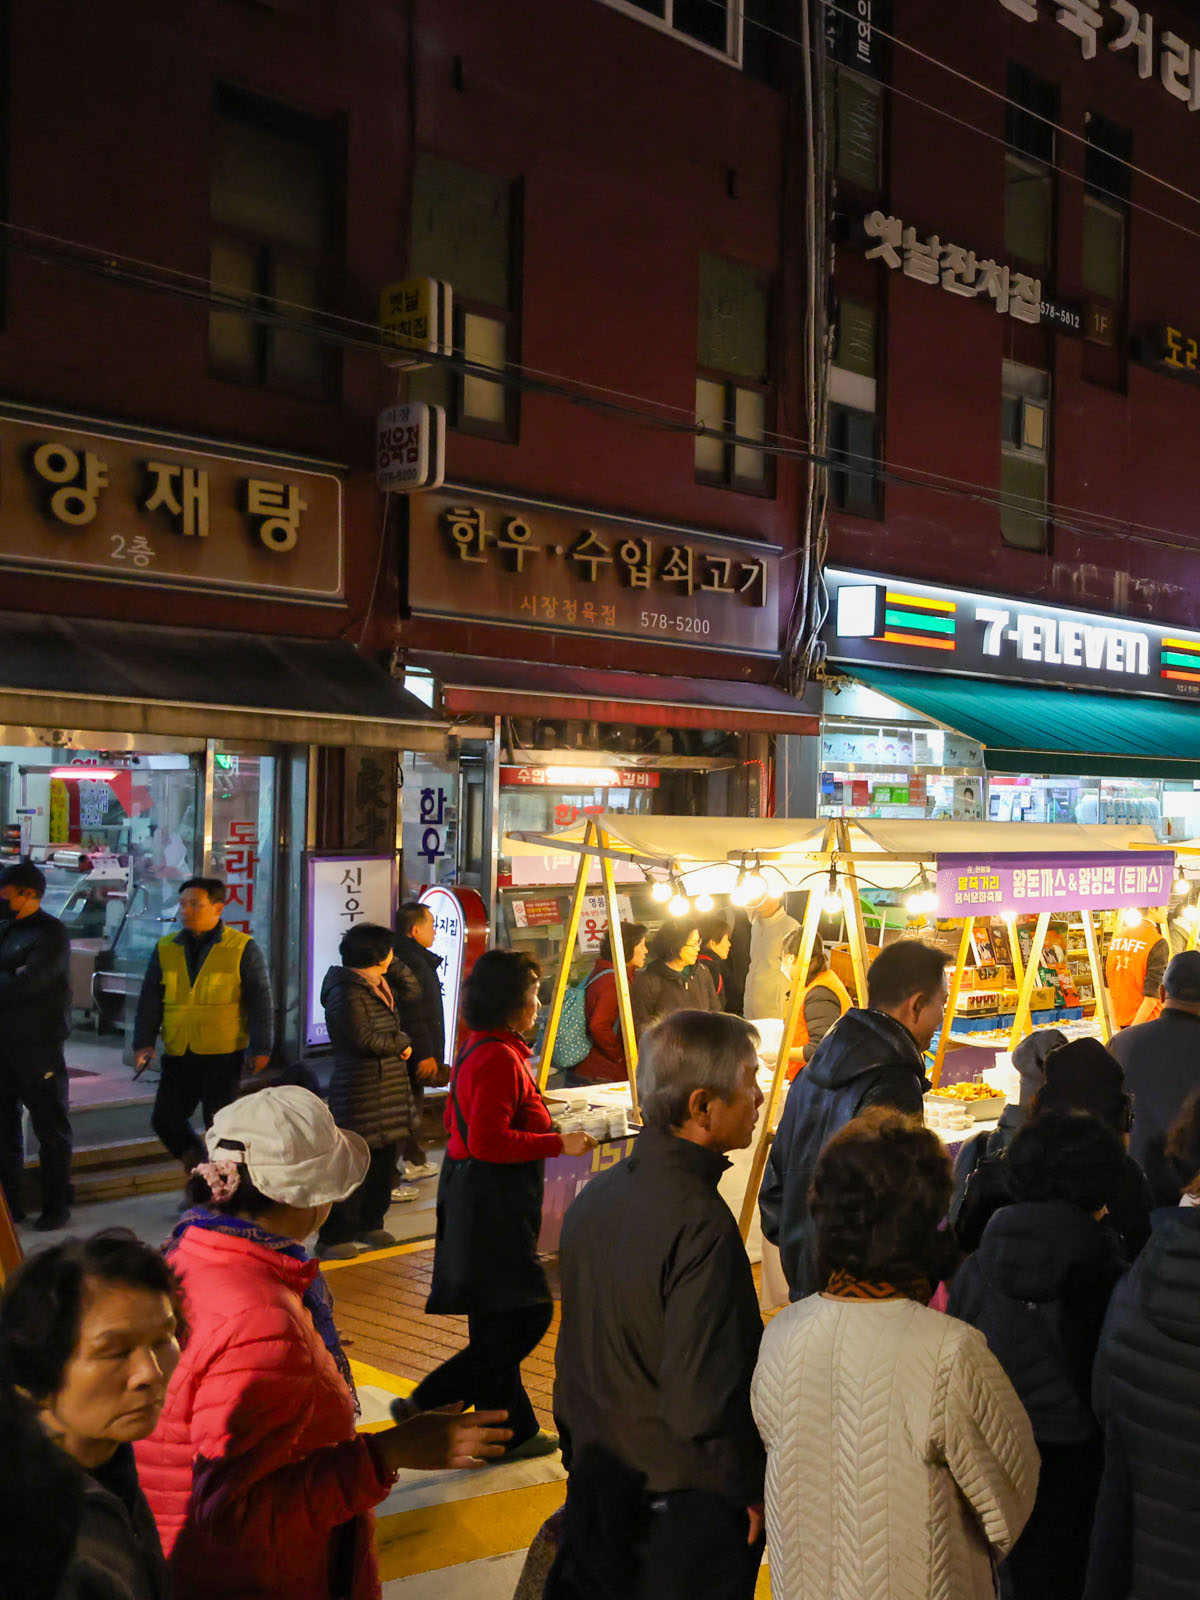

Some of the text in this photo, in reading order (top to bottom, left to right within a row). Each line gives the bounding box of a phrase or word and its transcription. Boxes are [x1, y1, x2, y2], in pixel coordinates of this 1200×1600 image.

[864, 210, 1041, 324] 옛날잔치집
[1040, 302, 1113, 334] 578-5812 1F
[379, 424, 420, 468] 정육점
[34, 443, 308, 552] 양재탕
[110, 534, 155, 568] 2층
[520, 594, 616, 627] 시장정육점
[640, 612, 711, 635] 578-5200
[417, 786, 447, 864] 한우
[957, 875, 1000, 891] 말죽거리
[1012, 865, 1164, 899] 왕돈까스 & 왕냉면 (돈까스)
[1109, 937, 1147, 953] STAFF
